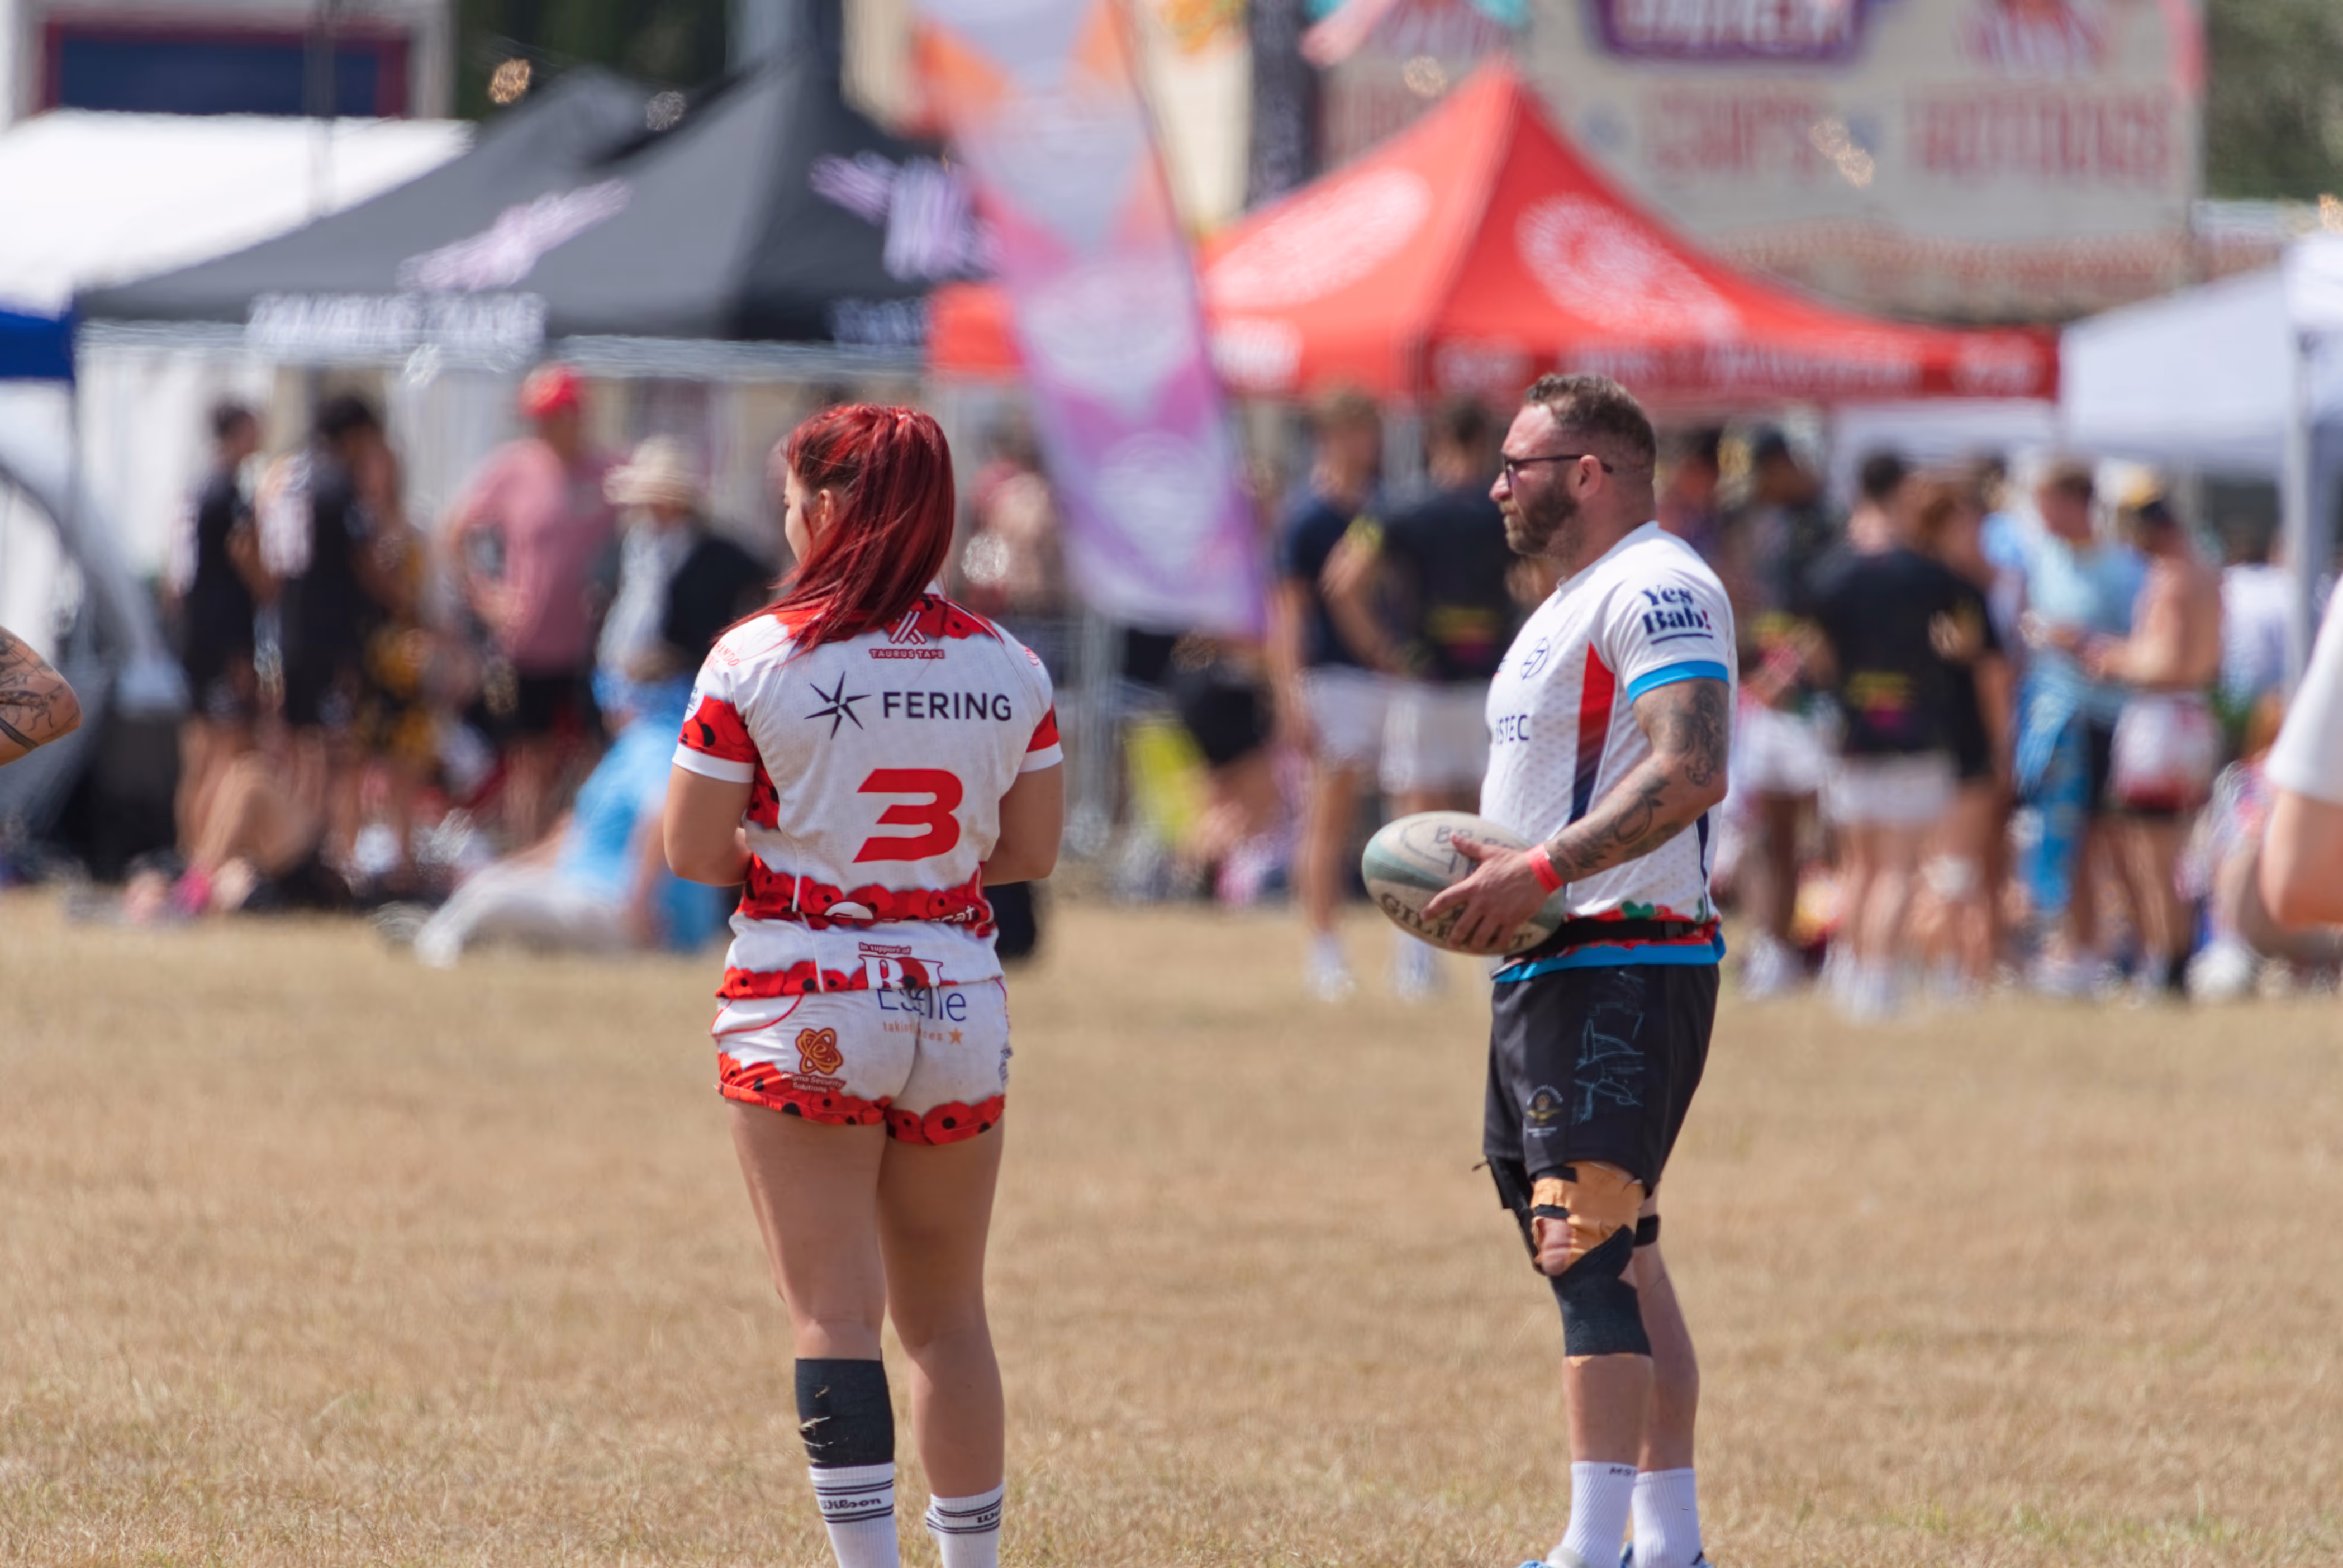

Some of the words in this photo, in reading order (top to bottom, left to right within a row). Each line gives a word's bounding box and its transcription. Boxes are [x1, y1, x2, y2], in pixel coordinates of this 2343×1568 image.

[1641, 585, 1694, 606] Yes
[883, 691, 1011, 721] FERING
[852, 768, 963, 863] 3
[792, 1082, 828, 1094] Solutions
[810, 1076, 843, 1088] Security
[819, 1498, 882, 1510] Wilson
